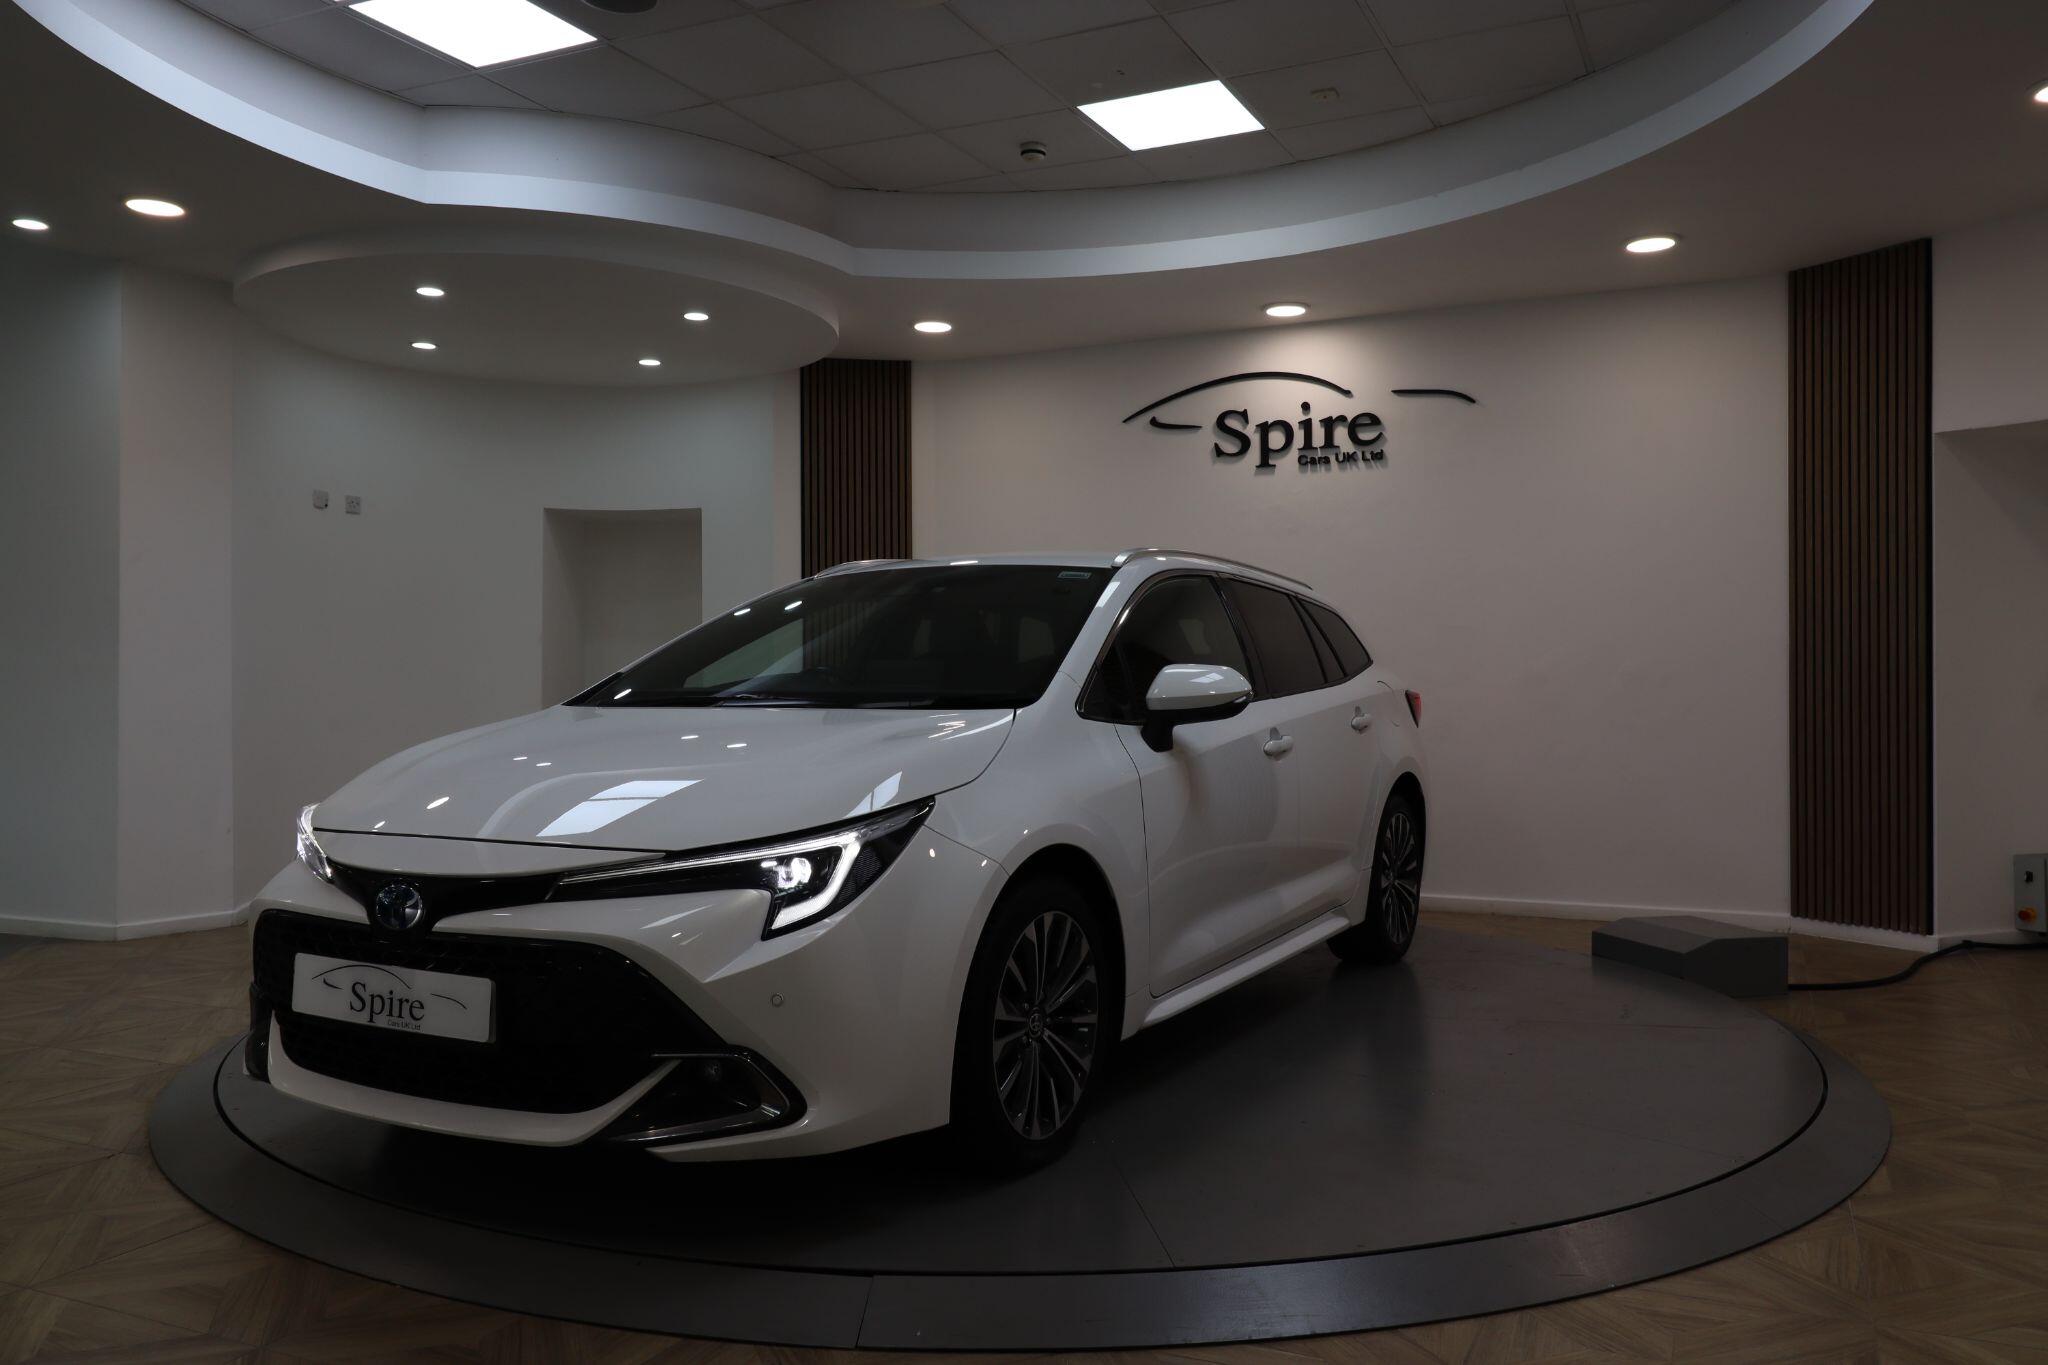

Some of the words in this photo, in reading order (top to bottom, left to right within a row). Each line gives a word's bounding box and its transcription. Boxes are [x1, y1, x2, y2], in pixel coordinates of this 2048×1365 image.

[1214, 402, 1383, 468] Spire
[1298, 454, 1331, 466] Cars
[1335, 451, 1358, 464] UK
[1361, 448, 1384, 462] Ltd
[350, 982, 425, 1023] Spire
